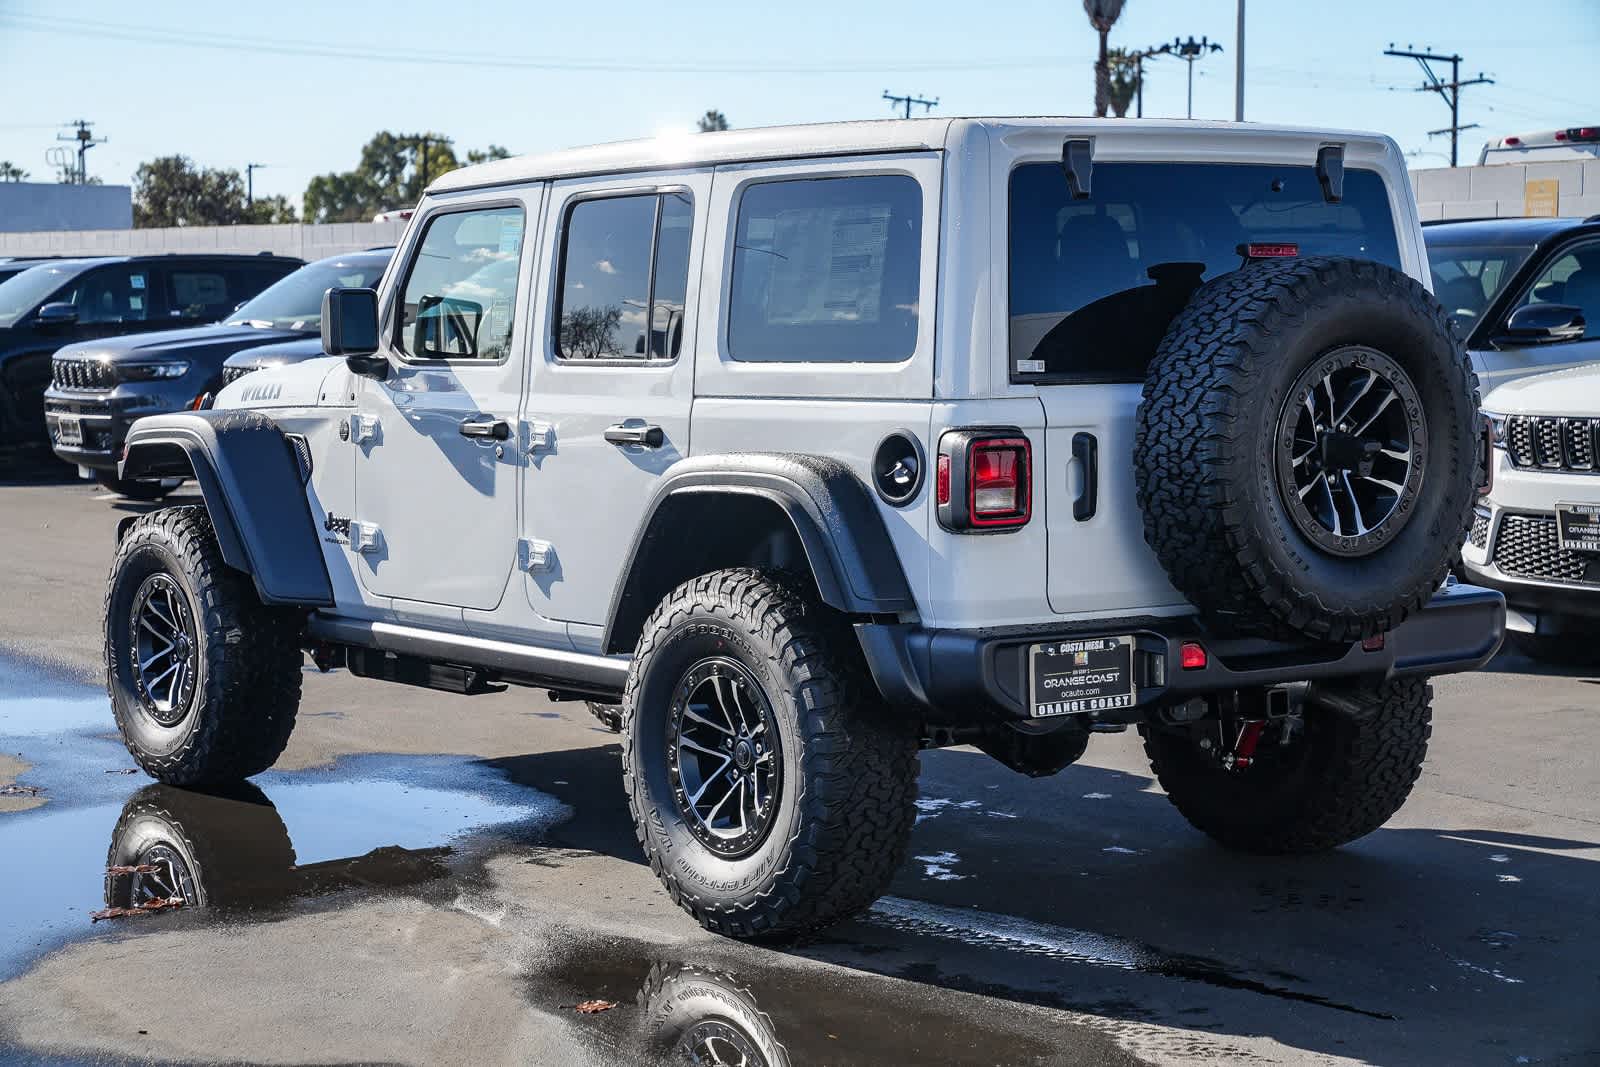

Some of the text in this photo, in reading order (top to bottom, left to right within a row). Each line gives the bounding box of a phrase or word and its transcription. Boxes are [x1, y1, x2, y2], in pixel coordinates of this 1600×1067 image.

[1060, 640, 1104, 653] COSTA MESA
[1061, 687, 1100, 698] ocauto.com
[1038, 695, 1129, 715] ORANGE COAST
